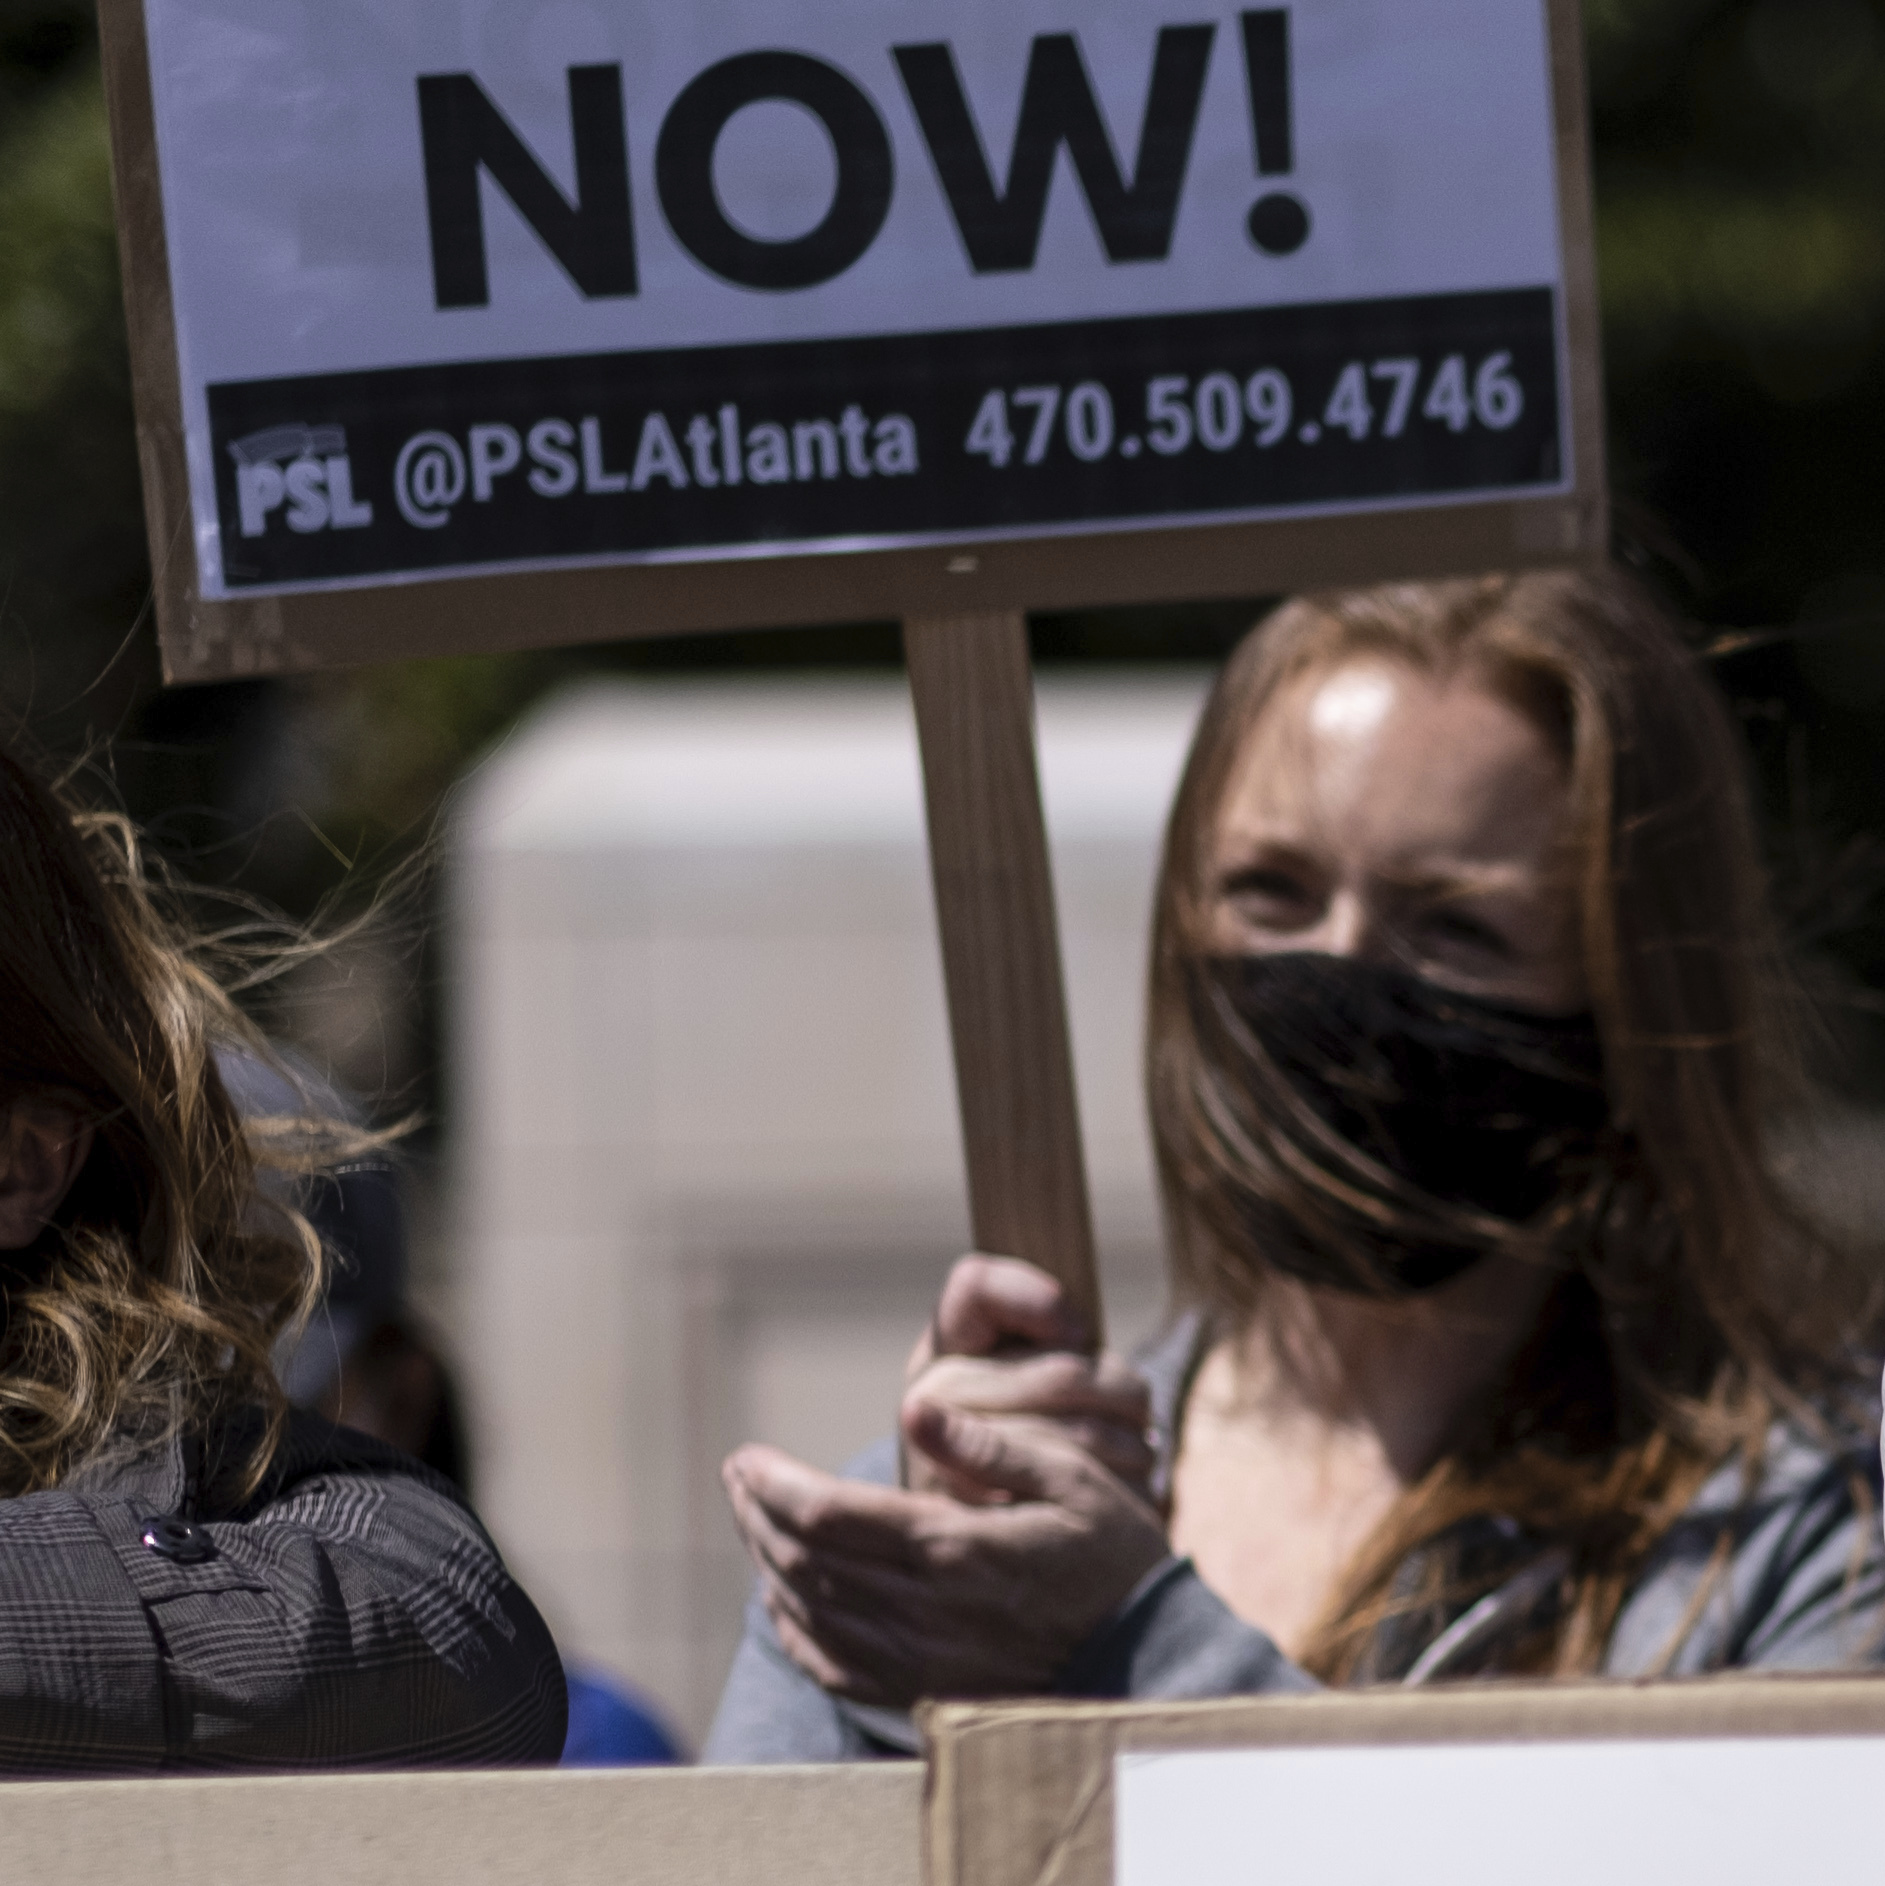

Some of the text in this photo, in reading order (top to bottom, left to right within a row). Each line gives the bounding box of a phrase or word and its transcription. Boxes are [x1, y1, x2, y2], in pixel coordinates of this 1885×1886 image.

[414, 6, 1312, 312] NOW!
[235, 349, 1525, 539] PSL @PSLAtlanta 470.509.4746
